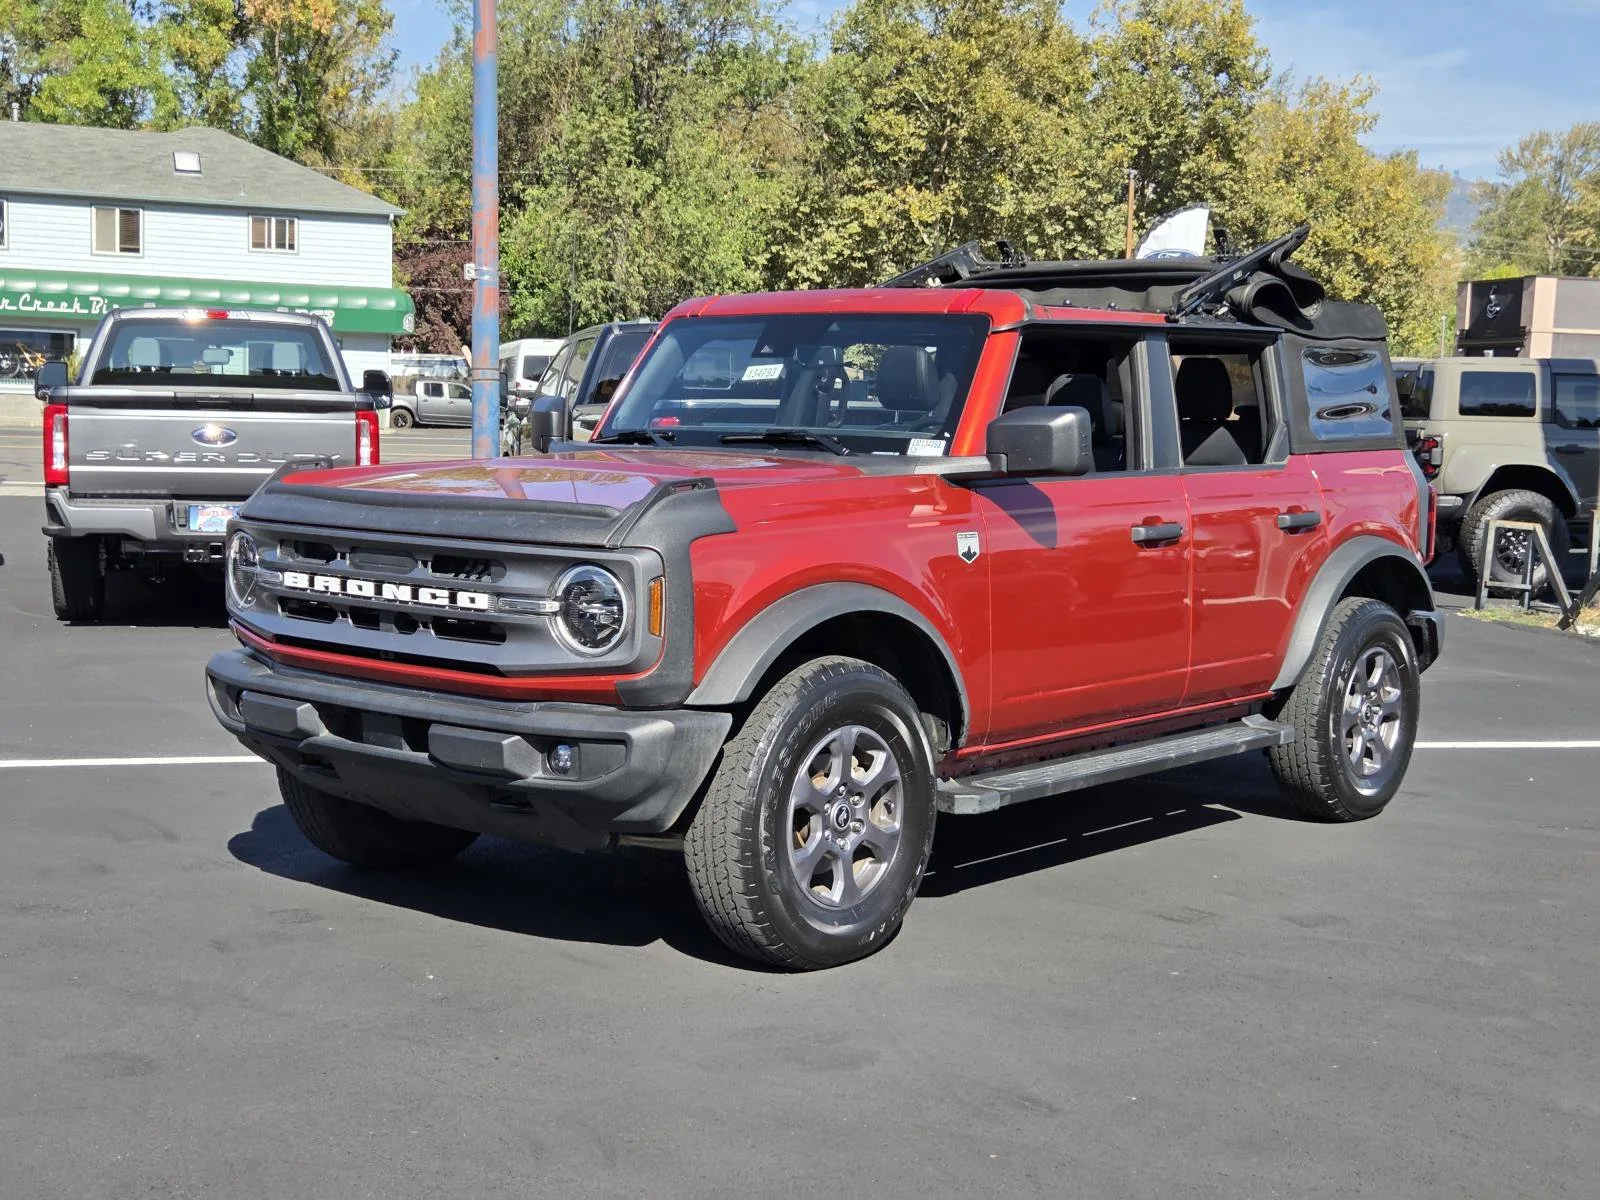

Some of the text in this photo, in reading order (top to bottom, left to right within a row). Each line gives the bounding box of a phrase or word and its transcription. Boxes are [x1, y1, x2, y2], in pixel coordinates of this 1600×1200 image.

[19, 293, 89, 313] Creek
[86, 451, 226, 463] SUPER
[284, 571, 489, 610] BRONCO
